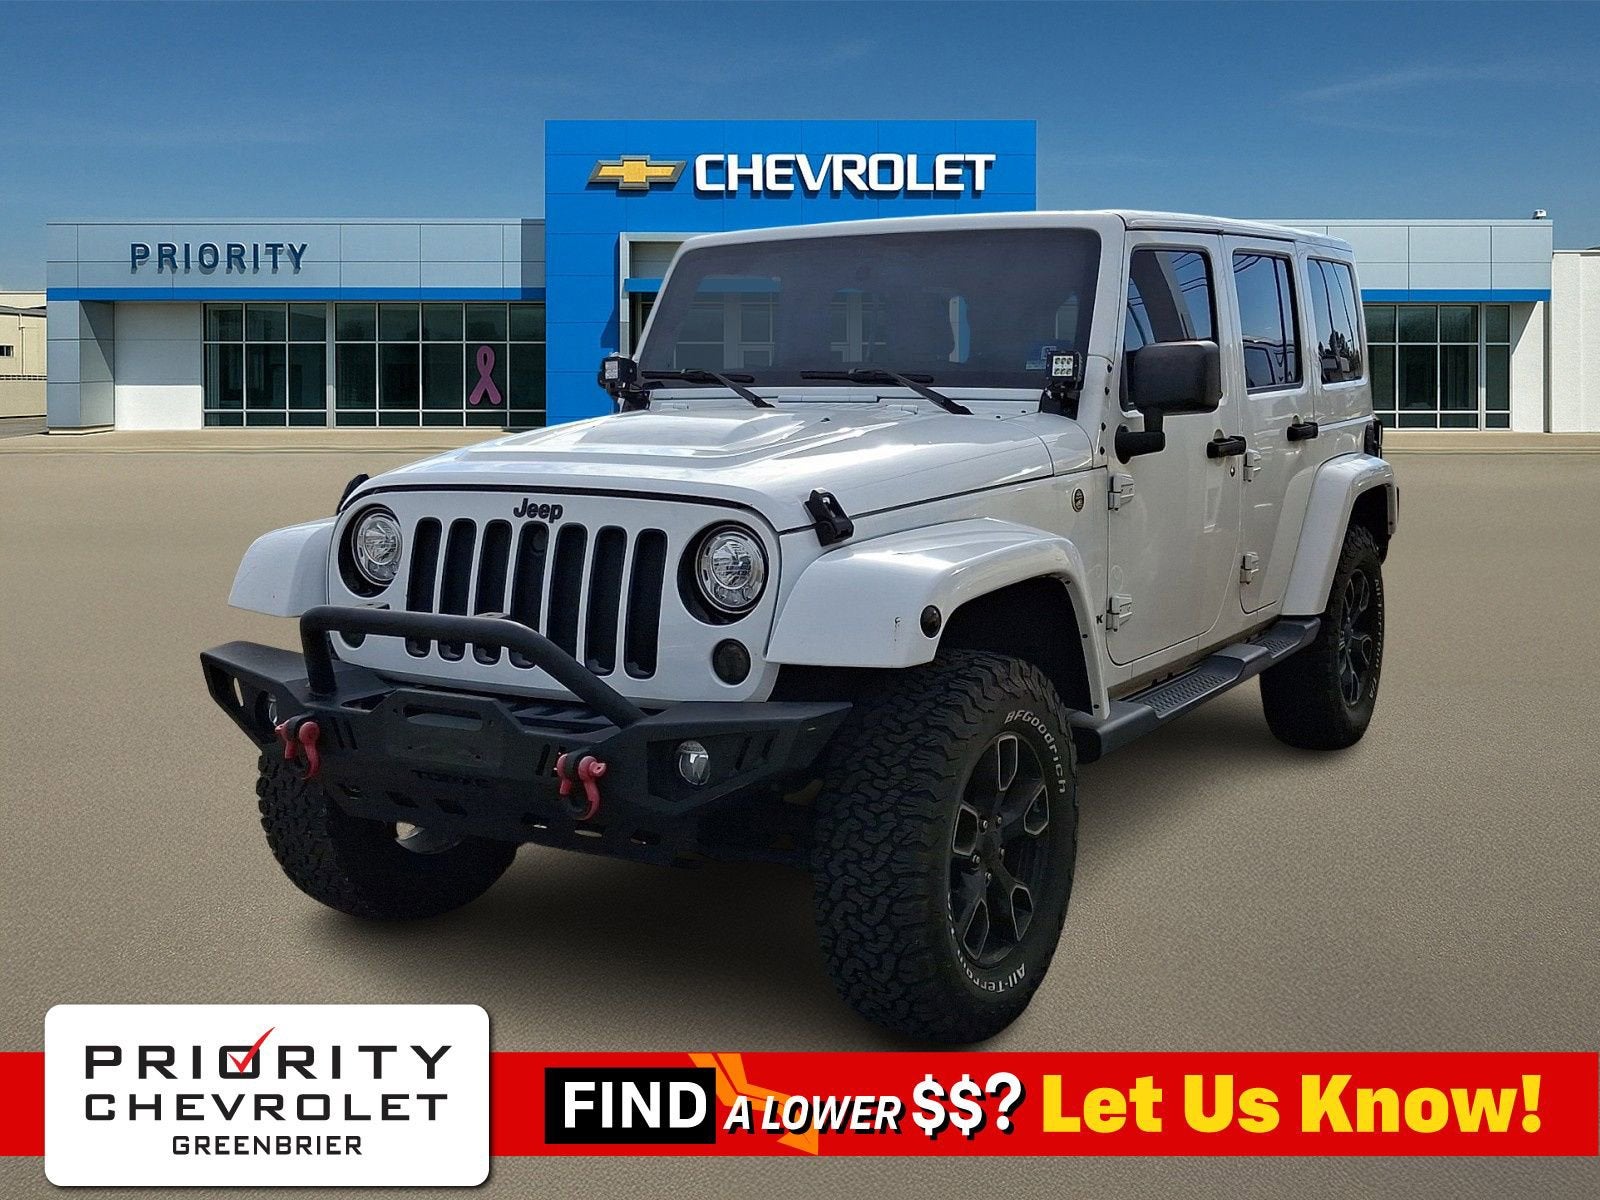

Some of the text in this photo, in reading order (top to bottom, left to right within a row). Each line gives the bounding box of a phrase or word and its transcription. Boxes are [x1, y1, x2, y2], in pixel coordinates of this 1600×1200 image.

[695, 153, 996, 192] CHEVROLET
[130, 242, 308, 271] PRIORITY
[513, 497, 563, 524] Jeep
[1003, 709, 1066, 793] BFGoodrich
